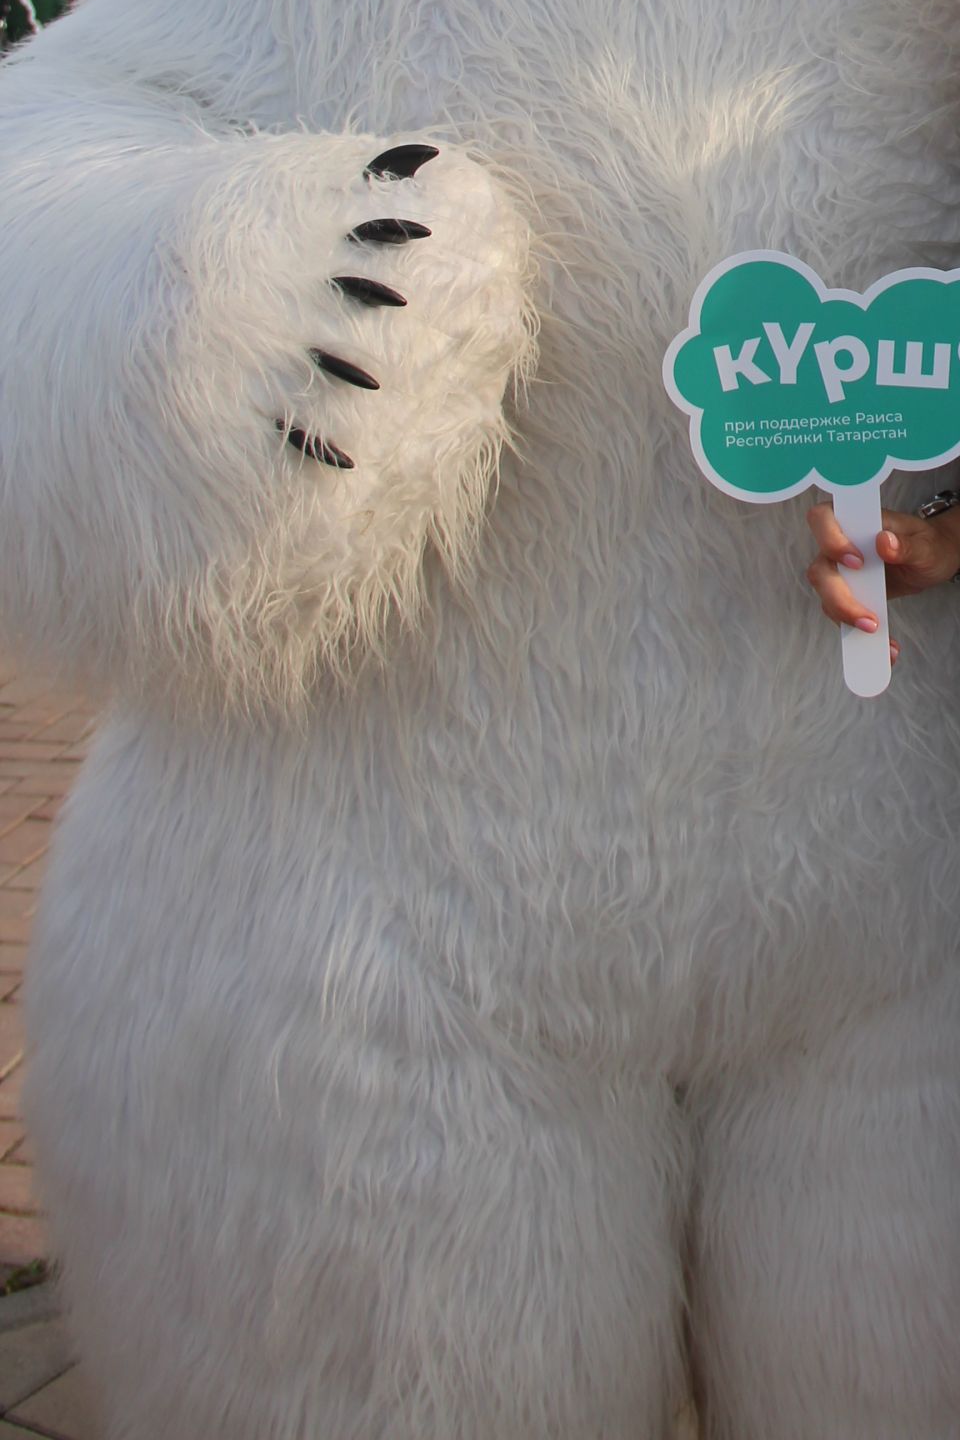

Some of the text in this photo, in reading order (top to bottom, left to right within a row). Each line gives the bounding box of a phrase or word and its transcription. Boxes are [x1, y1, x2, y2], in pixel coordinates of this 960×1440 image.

[724, 412, 903, 434] при поддержке Раиса
[726, 428, 907, 448] Республики Татарстан
